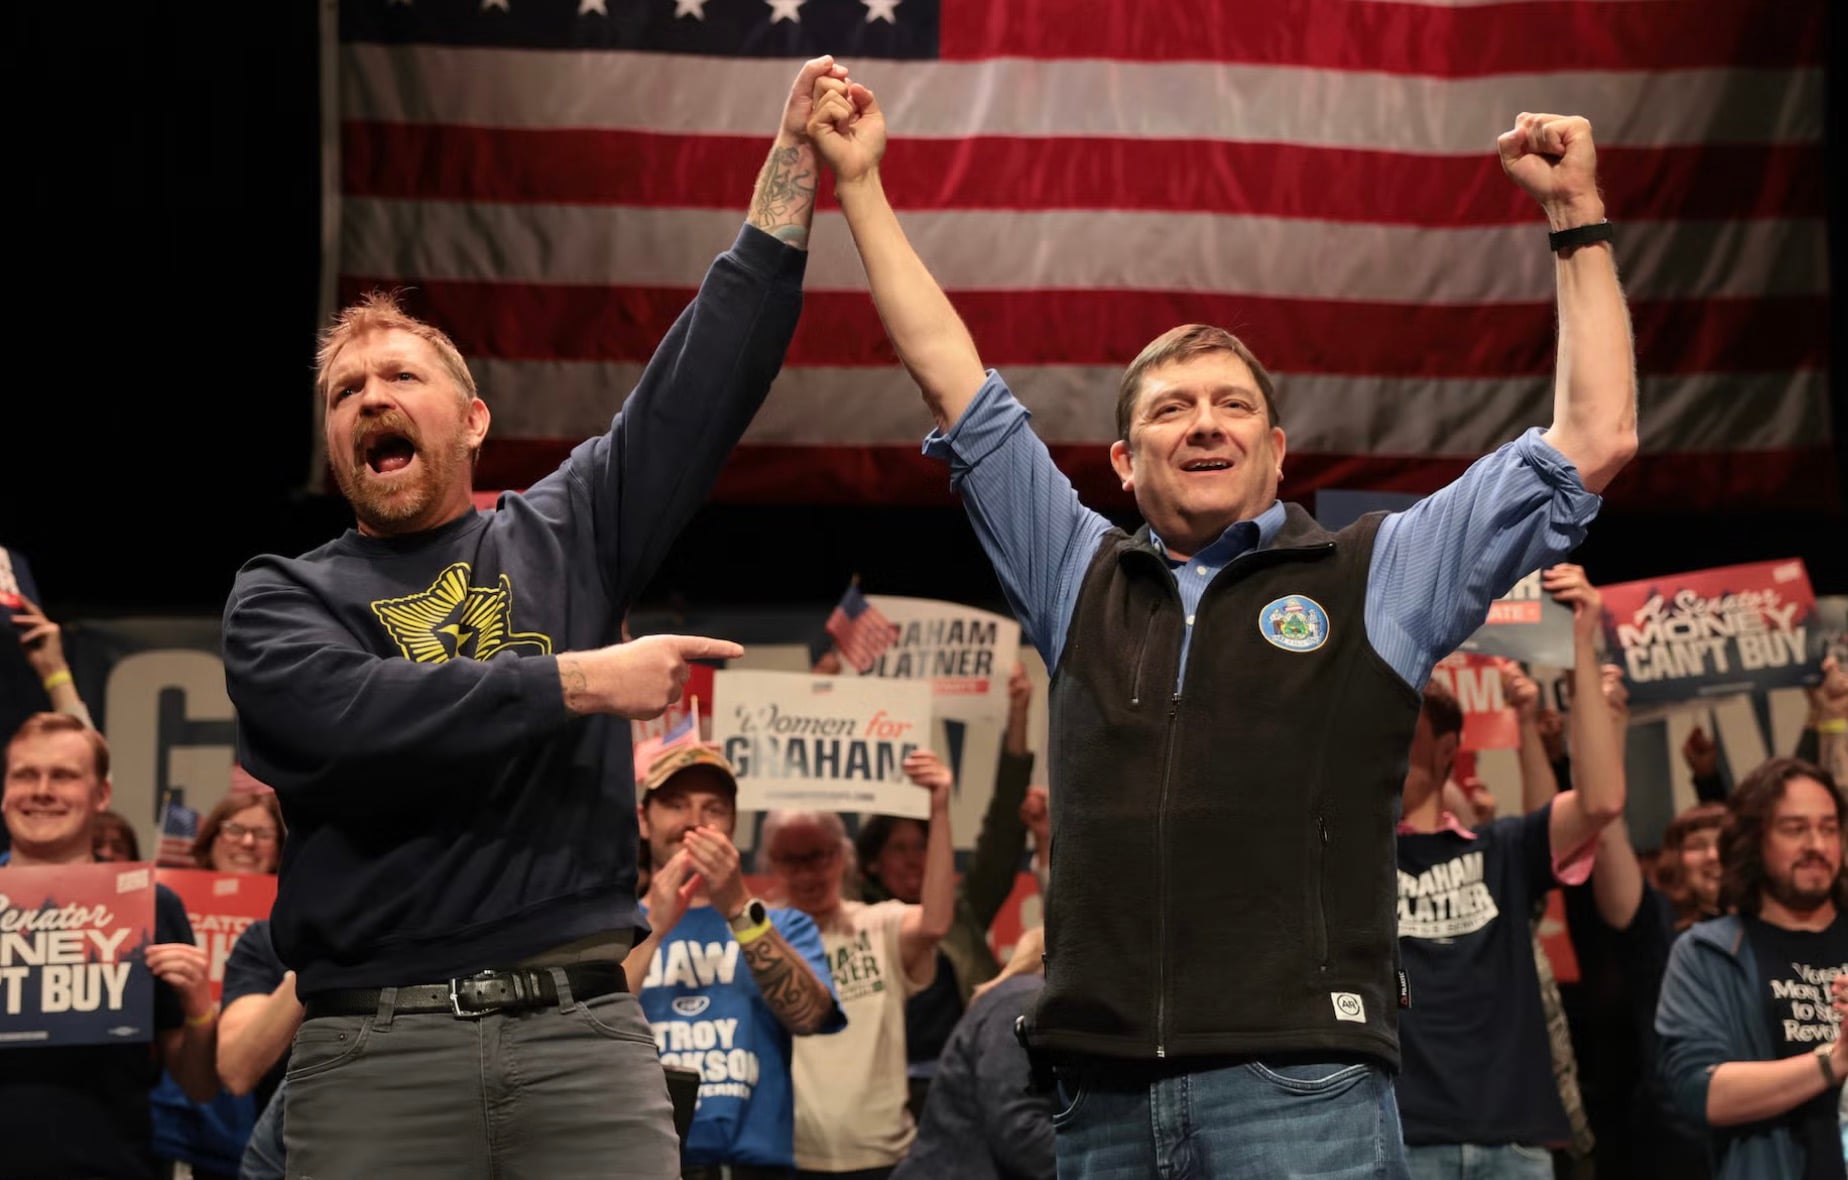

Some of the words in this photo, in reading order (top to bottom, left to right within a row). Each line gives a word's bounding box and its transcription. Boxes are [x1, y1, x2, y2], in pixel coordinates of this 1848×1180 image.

[1617, 602, 1798, 650] MONEY
[1624, 640, 1730, 684] CAN'T
[1736, 625, 1808, 671] BUY
[864, 710, 912, 738] for
[0, 893, 115, 932] enator
[41, 961, 132, 1014] BUY
[651, 1018, 738, 1053] TROY
